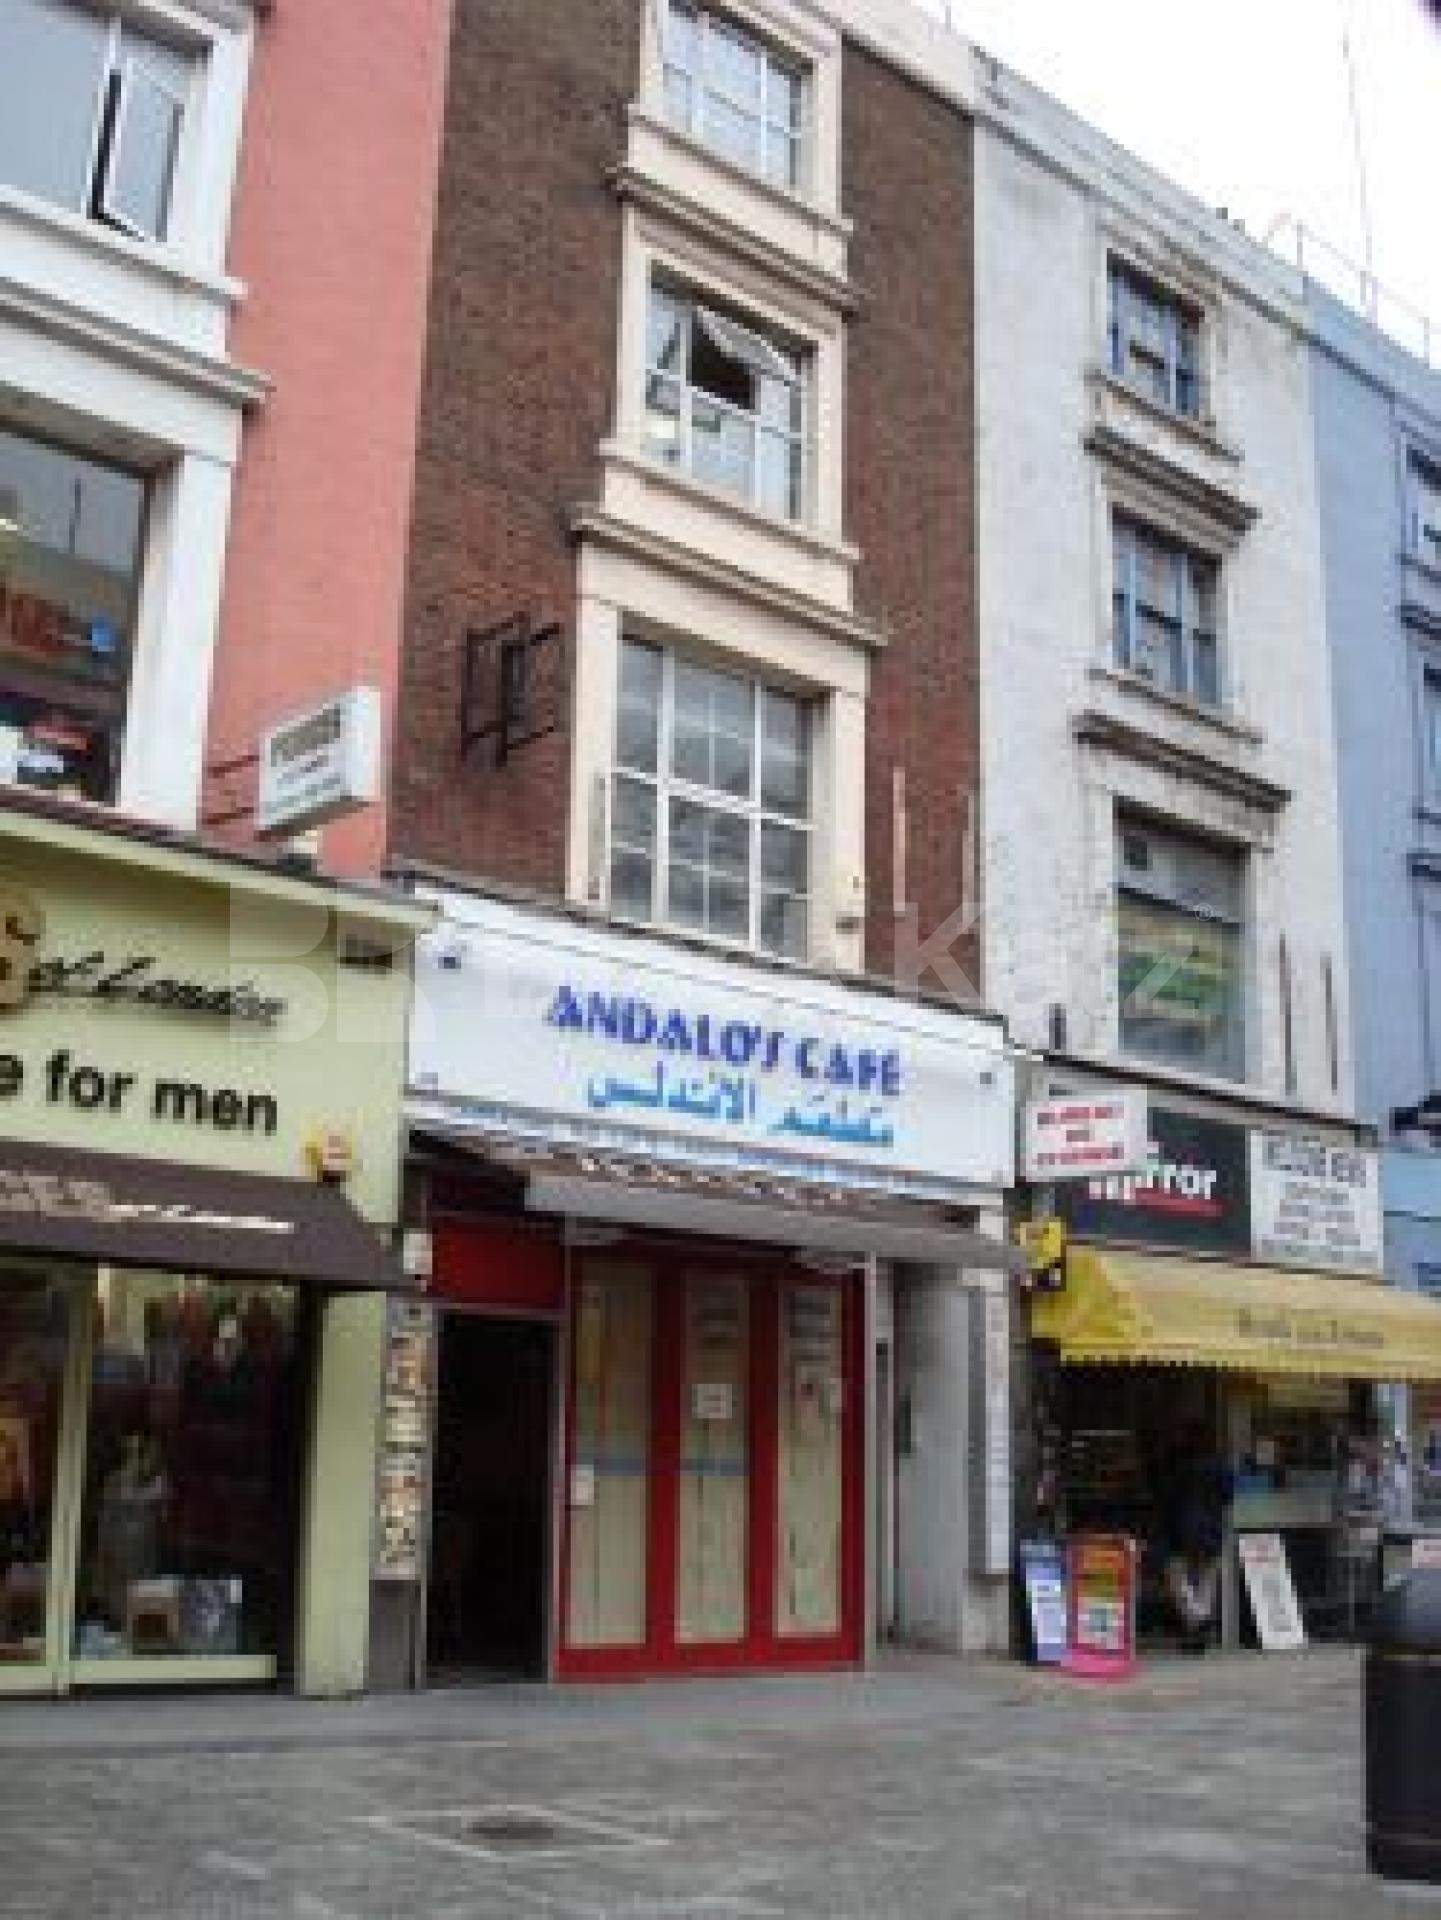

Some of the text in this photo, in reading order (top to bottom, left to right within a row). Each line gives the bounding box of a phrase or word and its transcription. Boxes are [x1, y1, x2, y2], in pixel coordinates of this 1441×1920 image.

[544, 984, 901, 1098] ANDALO'S CAFE
[46, 1048, 138, 1110] for
[151, 1075, 279, 1138] men
